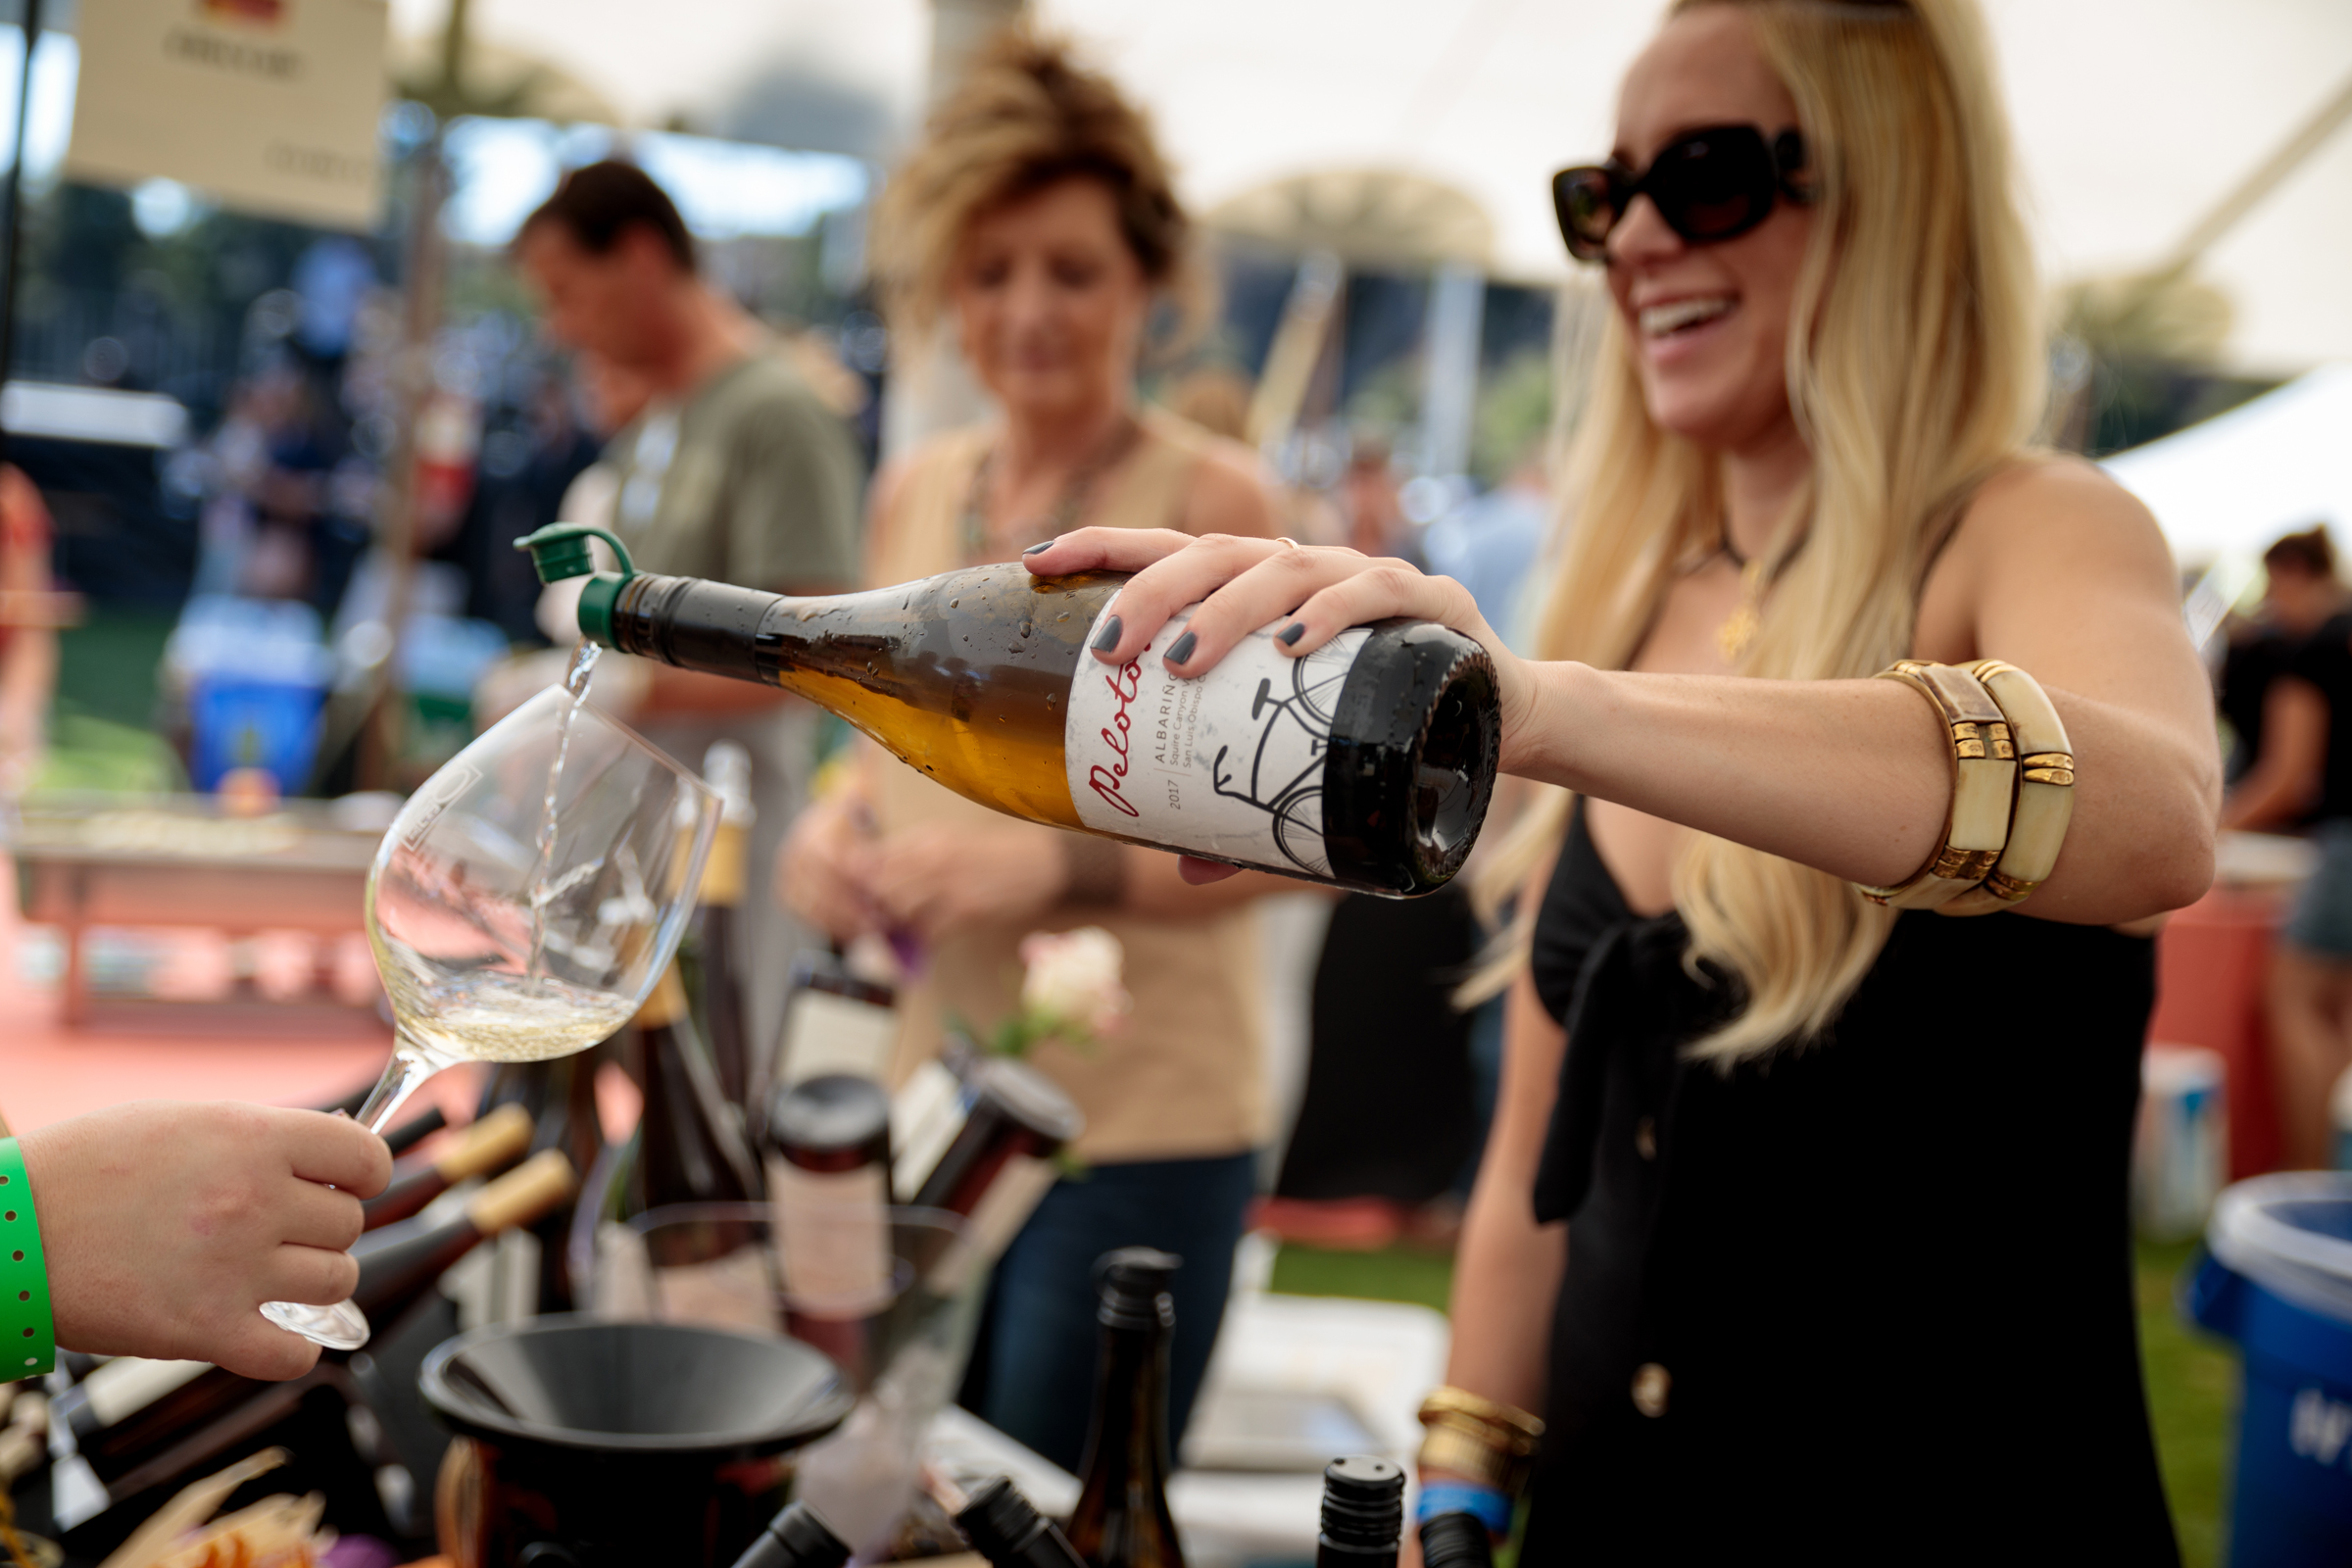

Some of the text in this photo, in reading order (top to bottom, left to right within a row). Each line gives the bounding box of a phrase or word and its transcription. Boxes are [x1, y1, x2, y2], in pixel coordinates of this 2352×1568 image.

[1172, 690, 1188, 731] Canyon
[1187, 685, 1202, 723] Obispo
[1088, 642, 1152, 817] Peloto
[1184, 725, 1195, 747] Luis
[1169, 733, 1181, 766] Squire
[1182, 750, 1192, 768] San
[1167, 779, 1181, 810] 2017
